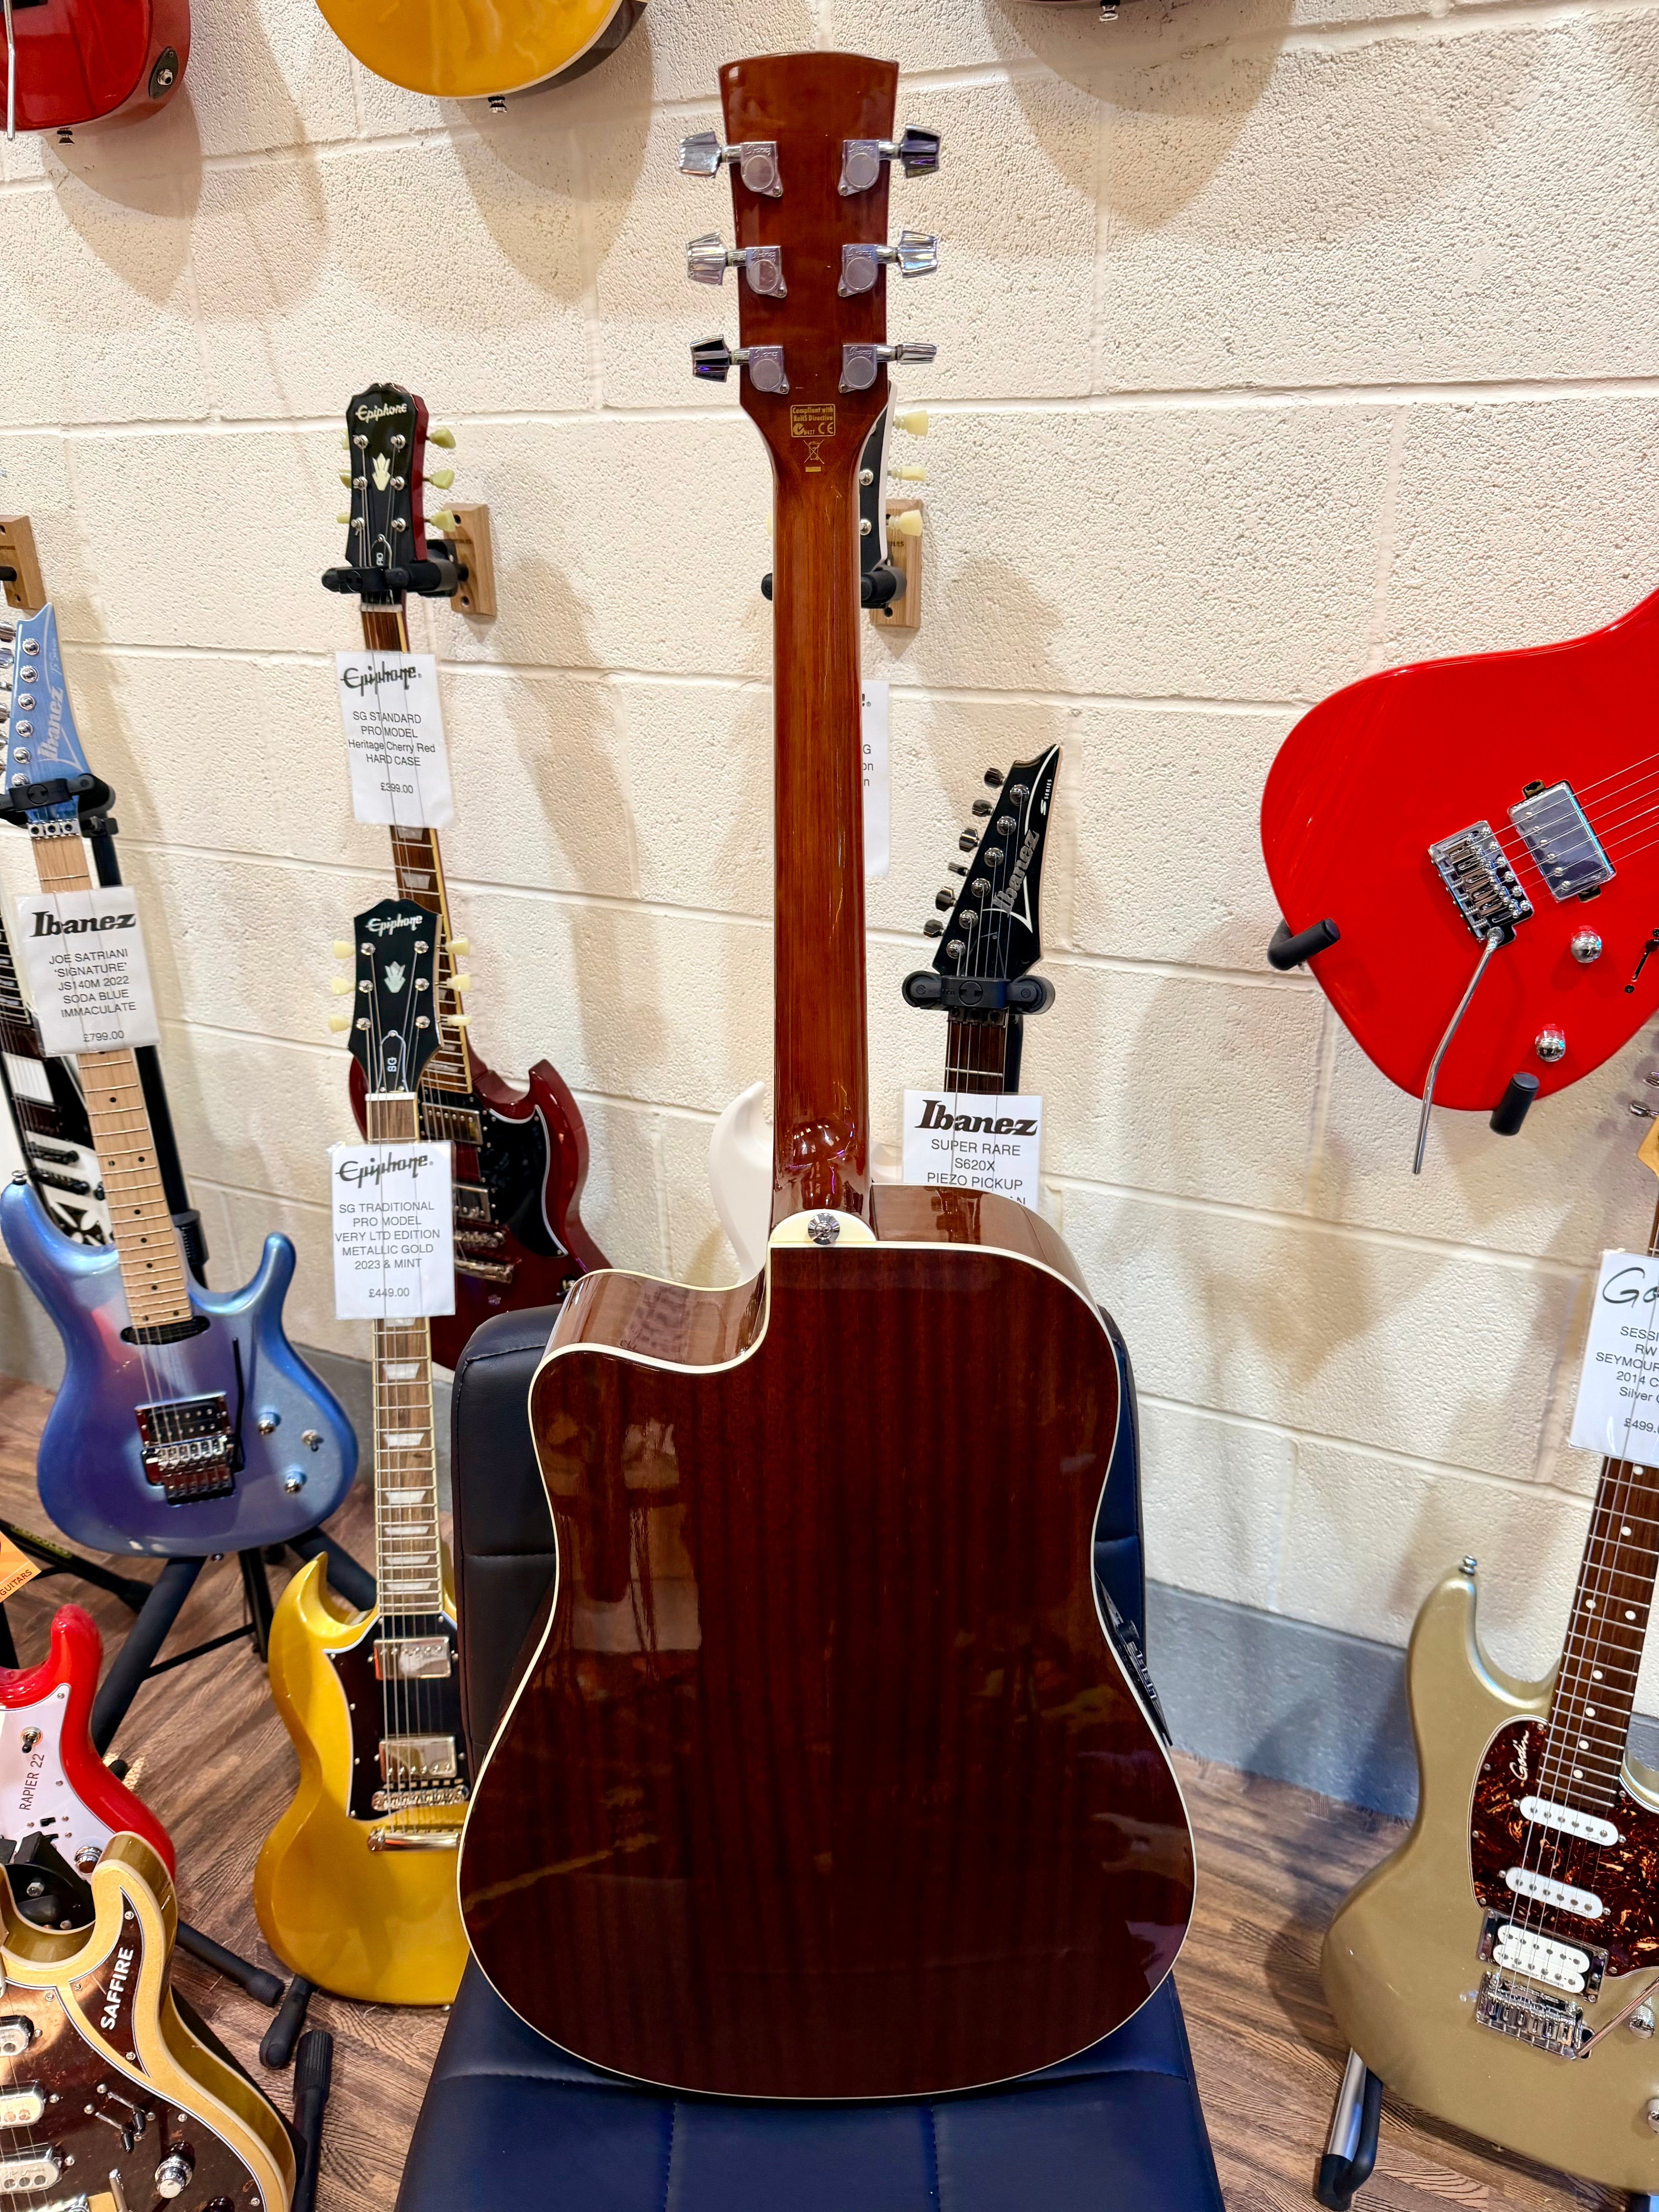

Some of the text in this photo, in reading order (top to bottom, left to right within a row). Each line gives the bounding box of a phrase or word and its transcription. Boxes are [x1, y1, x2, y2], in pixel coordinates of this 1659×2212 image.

[355, 403, 407, 423] Epiphone
[793, 406, 821, 414] Compliant
[340, 661, 416, 697] Epiphone
[353, 711, 421, 724] SG STANDARD
[361, 726, 418, 738] PRO MODEL
[349, 740, 435, 754] Heritage Cherry Red
[366, 754, 421, 766] HARD CASE
[381, 783, 413, 794] £399.00
[991, 829, 1040, 918] Ibanez
[29, 910, 136, 938] Ibanez
[366, 914, 422, 937] Epiphone
[49, 948, 128, 964] JOE SATRIANI
[58, 976, 129, 991] JS140M 2022
[64, 989, 129, 1004] SODA BLUE
[61, 1002, 136, 1018] IMMACULATE
[83, 1030, 124, 1042] £799.00
[914, 1099, 1038, 1136] Ibanez
[931, 1139, 1021, 1156] SUPER RARE
[335, 1152, 428, 1188] Epiphone
[955, 1158, 995, 1171] S620X
[927, 1172, 1023, 1190] PIEZO PICKUP
[340, 1202, 434, 1213] SG TRADITIONAL
[353, 1216, 421, 1226] PRO MODEL
[335, 1230, 440, 1242] VERY LTD EDITION
[343, 1244, 433, 1256] METALLIC GOLD
[355, 1259, 422, 1269] 2023 & MINT
[369, 1288, 409, 1298] £449.00
[1635, 1343, 1658, 1356] RW
[1616, 1371, 1659, 1388] 2014 C
[1619, 1387, 1653, 1402] Silver
[1509, 1730, 1529, 1781] Godin
[19, 1753, 45, 1810] RAPIER 22
[100, 1947, 134, 2030] SAFFIRE
